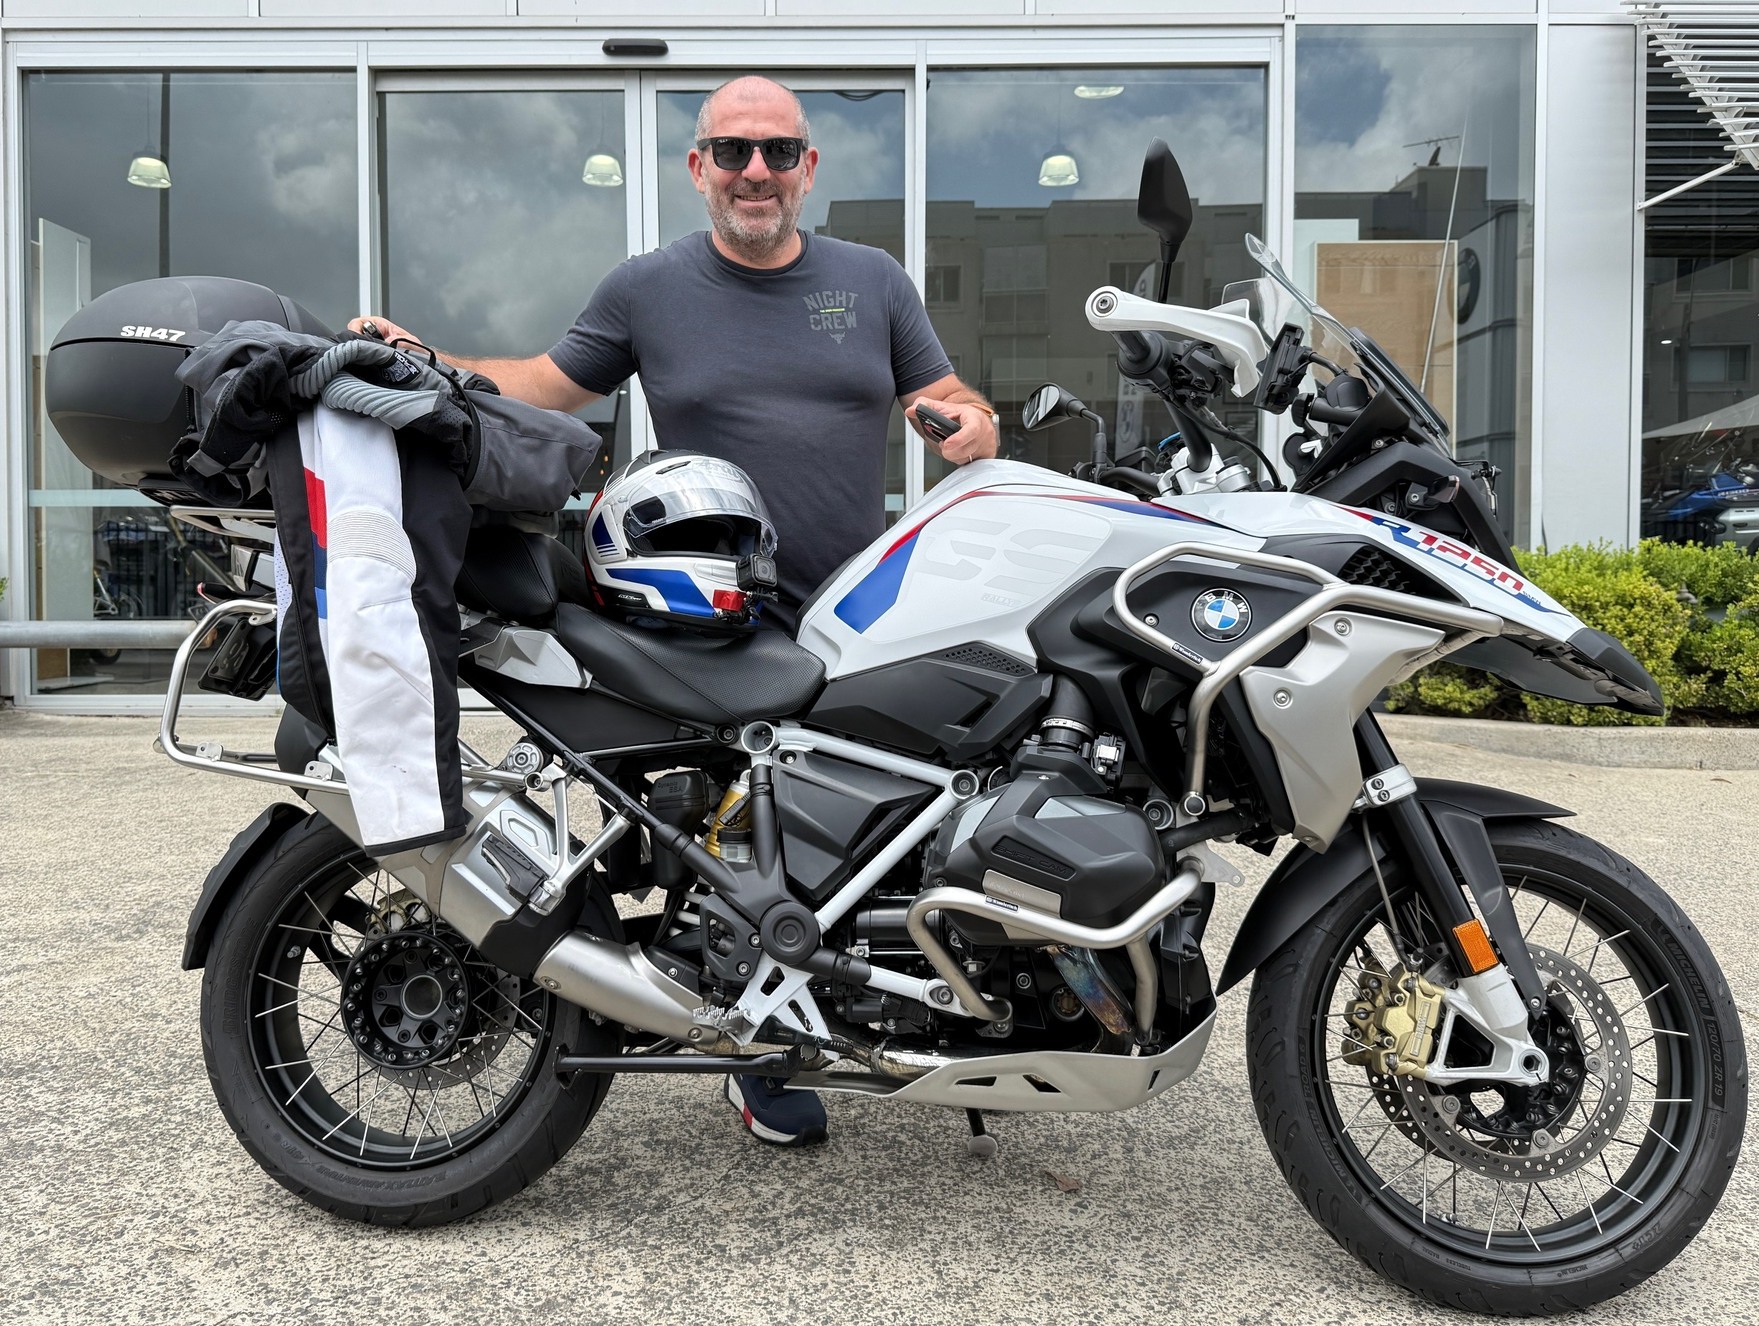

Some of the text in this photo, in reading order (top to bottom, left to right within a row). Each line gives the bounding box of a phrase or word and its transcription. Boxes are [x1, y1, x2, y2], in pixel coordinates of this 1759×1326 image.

[802, 290, 858, 311] NIGHT
[120, 325, 186, 341] SH47
[809, 311, 857, 330] CREW
[1417, 531, 1524, 596] 1250
[1204, 590, 1249, 613] BMW
[994, 846, 1069, 875] SHIFT CAM
[1667, 935, 1710, 1011] MICHELIN
[1299, 1055, 1314, 1098] ROAD
[1707, 1022, 1725, 1096] 120/70 ZR 19
[1309, 1109, 1347, 1180] MICHELIN
